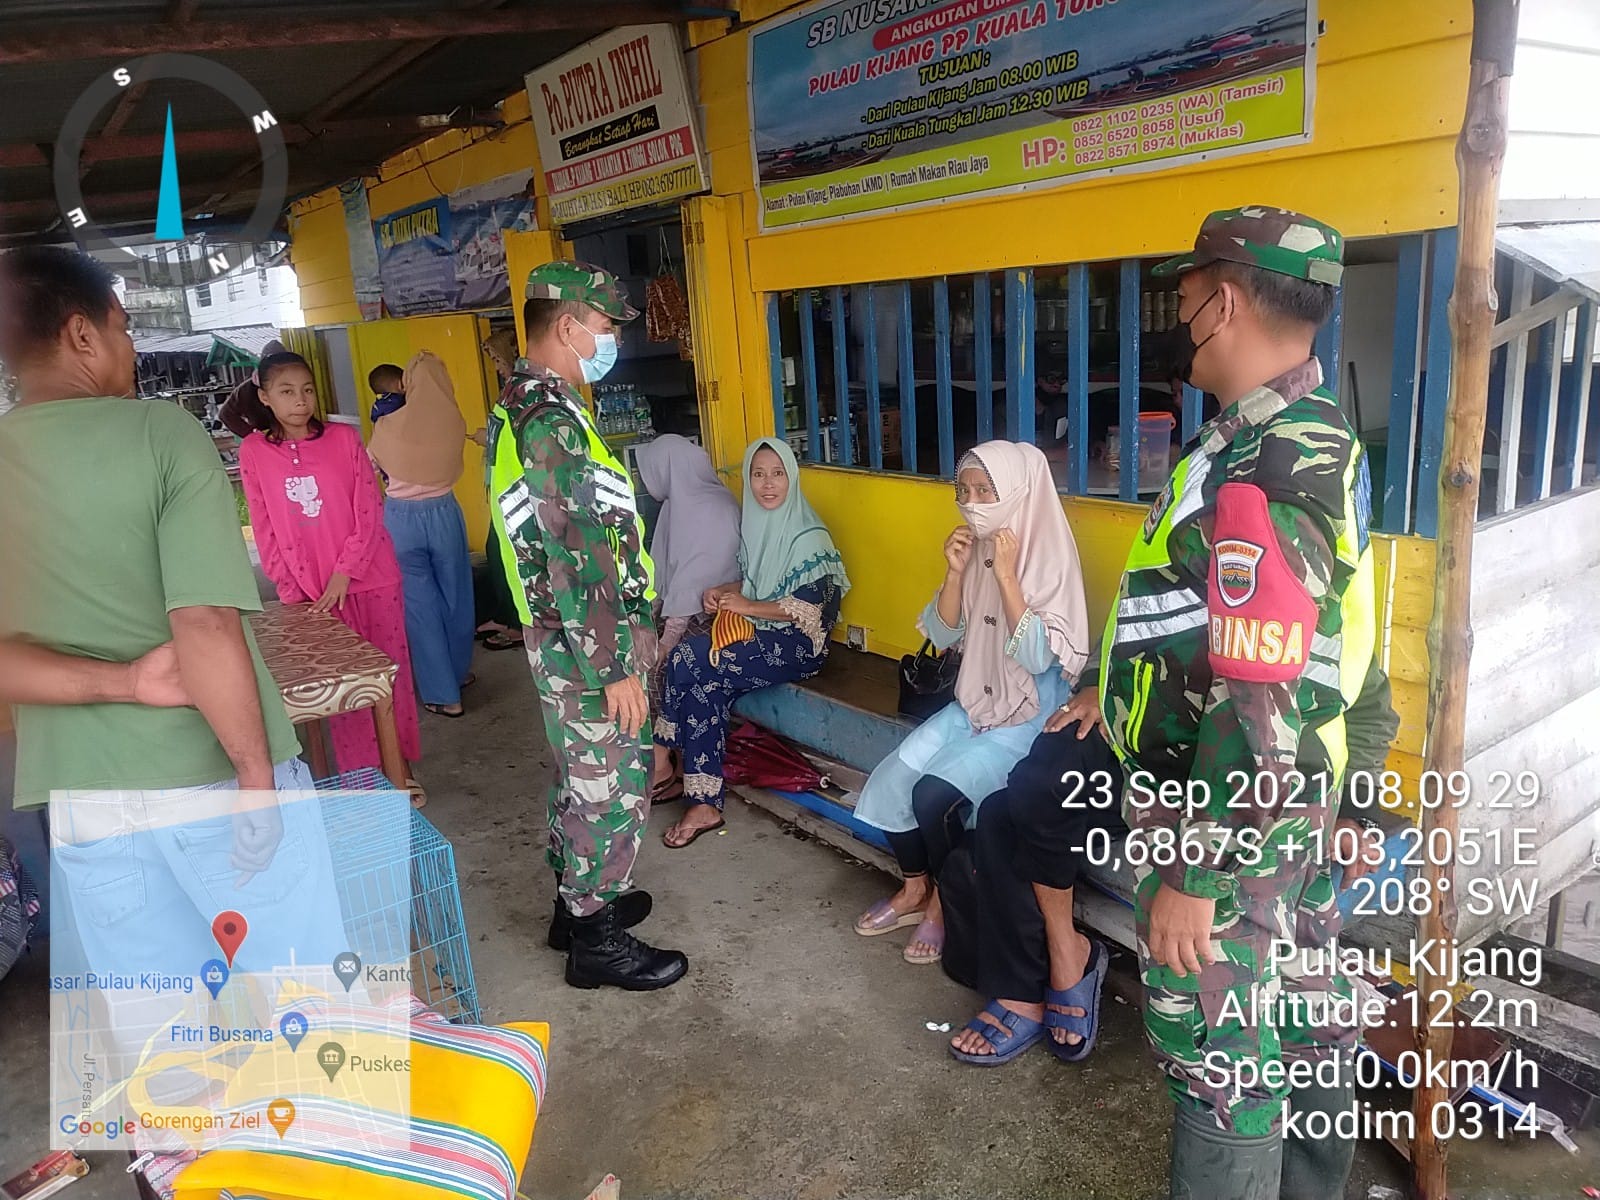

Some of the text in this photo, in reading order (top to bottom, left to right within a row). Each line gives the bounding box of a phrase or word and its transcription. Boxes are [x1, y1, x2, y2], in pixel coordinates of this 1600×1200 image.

[807, 16, 837, 48] SB
[891, 0, 978, 41] ANGKUTAN
[607, 34, 663, 109] INHIL
[808, 63, 861, 96] PULAU
[866, 41, 934, 78] KIJANG
[942, 29, 969, 55] PP
[975, 2, 1047, 45] KUALA
[868, 102, 891, 123] Dari
[893, 96, 926, 116] Pulau
[928, 82, 967, 107] Kijang
[969, 78, 996, 96] Jam
[1000, 62, 1042, 87] 08.00
[1046, 51, 1078, 75] WIB
[1073, 77, 1284, 132] 0822 1102 0235 (WA) (Tamsir)
[564, 113, 656, 158] Berangkat Setiap Hari
[868, 131, 891, 148] Dari
[893, 125, 926, 141] Kuala
[929, 108, 976, 131] Tungkal
[978, 103, 1006, 121] Jam
[1010, 89, 1053, 114] 12.30
[1057, 81, 1089, 103] WIB
[1022, 109, 1224, 168] HP: 0852 6520 8058 (Usuf)
[1075, 122, 1243, 164] 0822 8571 8974 (Muklas)
[789, 194, 805, 207] Pulau
[829, 182, 861, 199] Plabuhan
[861, 175, 883, 192] LKMD
[890, 169, 918, 187] Rumah
[918, 164, 947, 181] Makan
[948, 159, 968, 176] Riau
[969, 155, 989, 173] Jaya
[1209, 614, 1303, 665] BINSA
